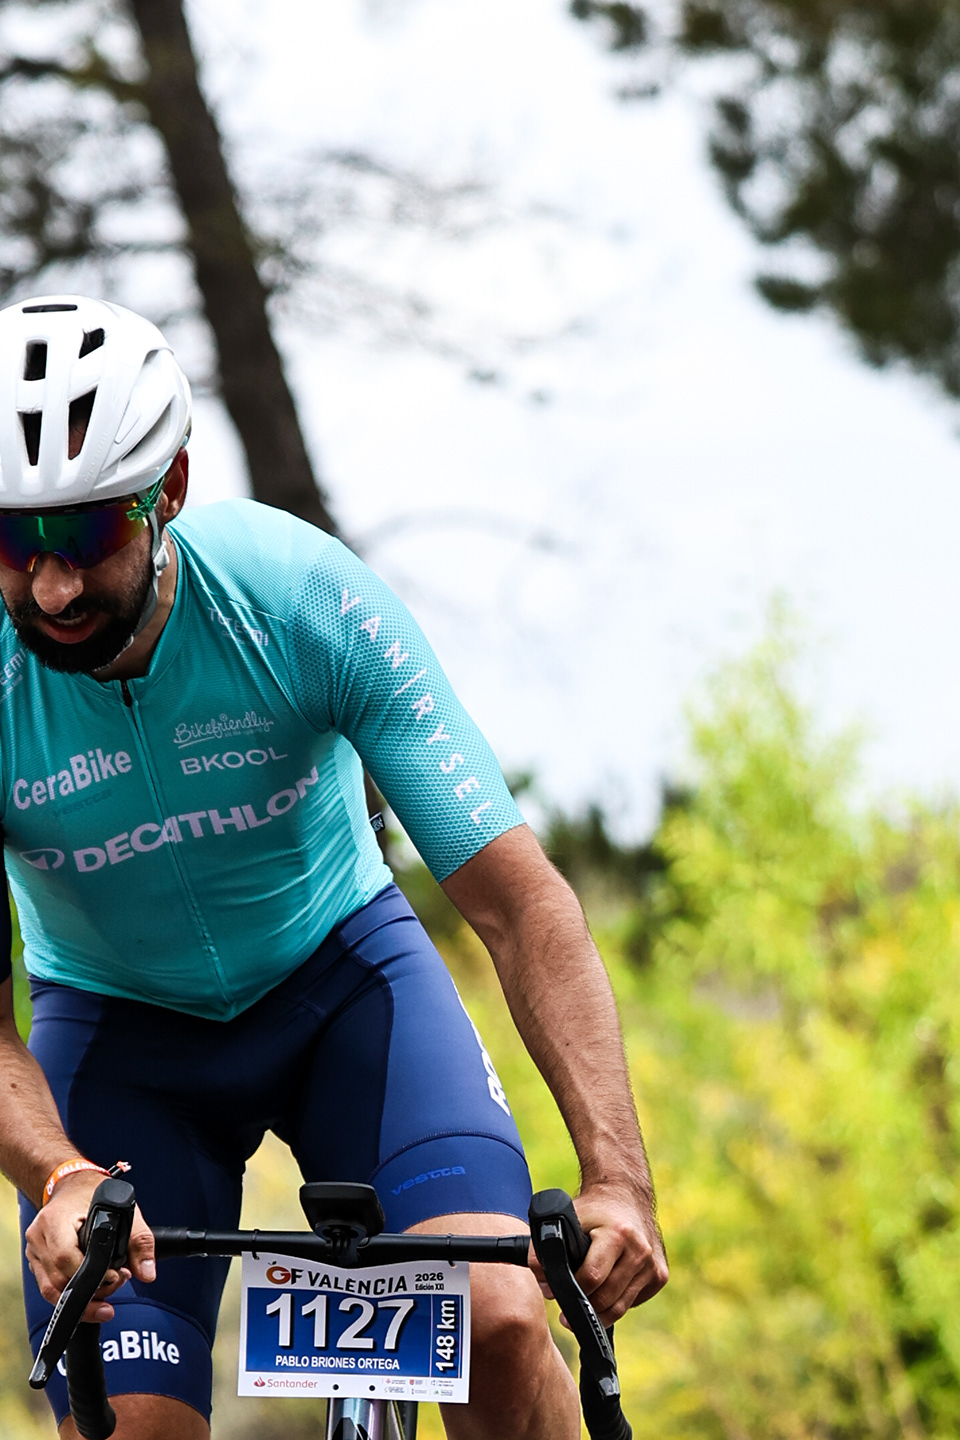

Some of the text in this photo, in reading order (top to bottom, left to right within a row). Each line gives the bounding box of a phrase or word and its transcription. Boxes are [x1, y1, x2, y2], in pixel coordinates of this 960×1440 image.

[173, 711, 274, 744] Bikefriendly
[180, 747, 288, 775] BKOOL
[13, 748, 132, 810] CeraBike
[73, 765, 319, 873] DECATHLON
[266, 1267, 303, 1285] GF
[415, 1272, 444, 1282] 2026
[266, 1294, 415, 1350] 1127
[436, 1300, 455, 1330] km
[275, 1355, 400, 1370] PABLO BRIONES ORTEGA
[435, 1335, 455, 1372] 148
[267, 1379, 318, 1389] Santander
